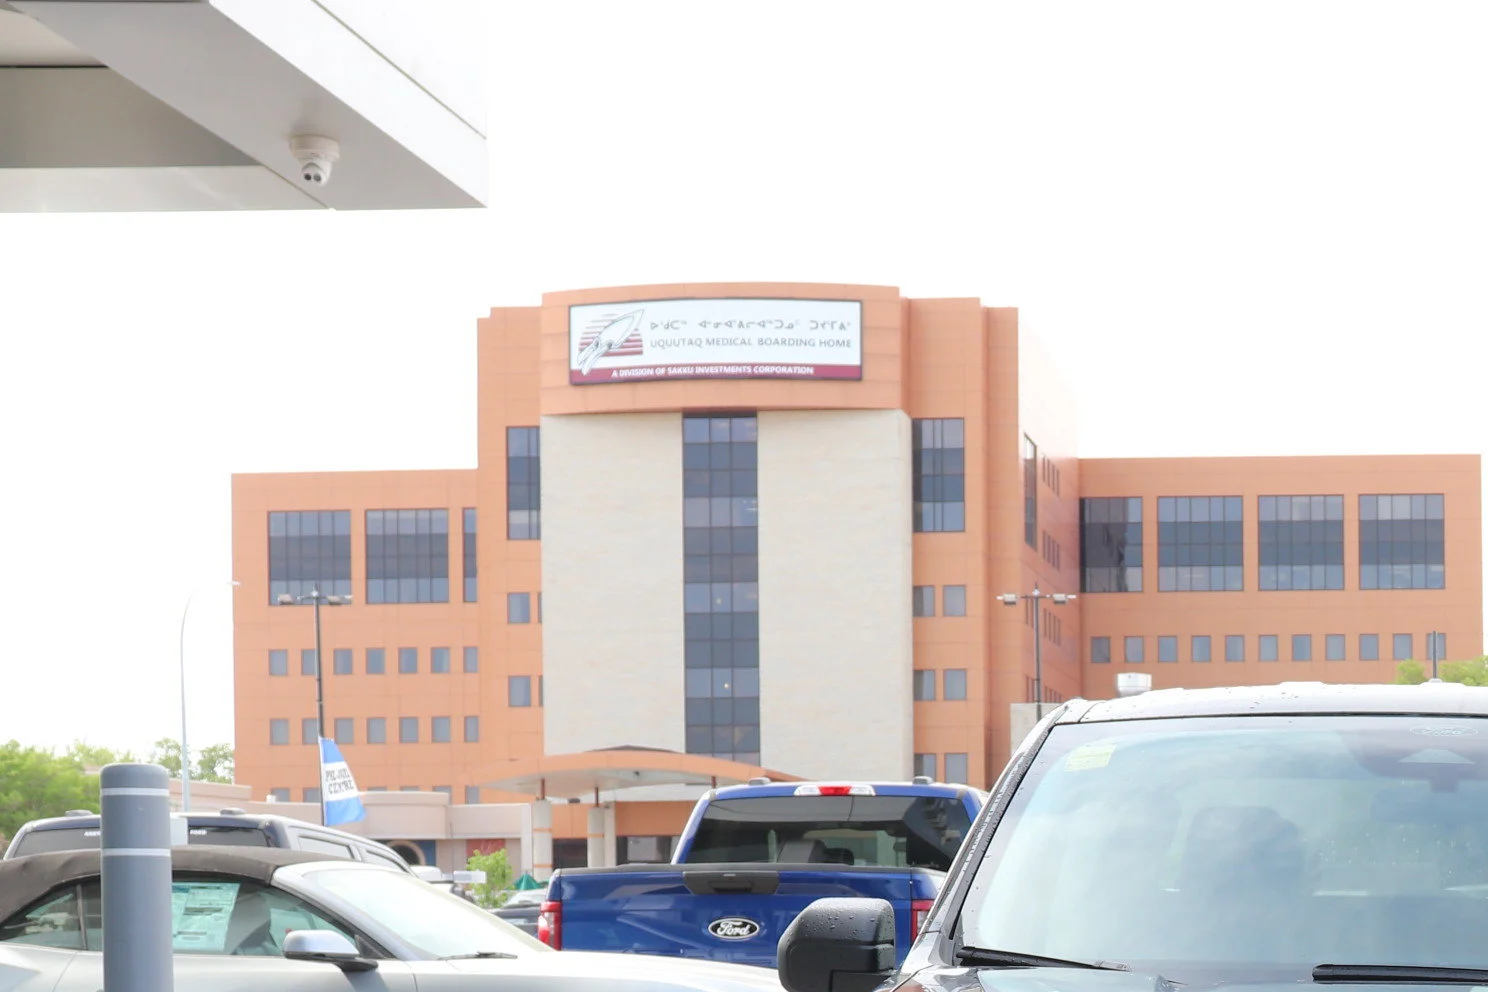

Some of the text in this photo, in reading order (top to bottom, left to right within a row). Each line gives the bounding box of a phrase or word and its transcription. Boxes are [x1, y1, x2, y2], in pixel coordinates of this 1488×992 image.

[650, 337, 852, 349] UQUUTAQ MEDICAL BOARDING HOME
[611, 365, 814, 378] A DIVISION OF SAKKU INVESTMENTS CORPORATION
[716, 921, 751, 936] Ford
